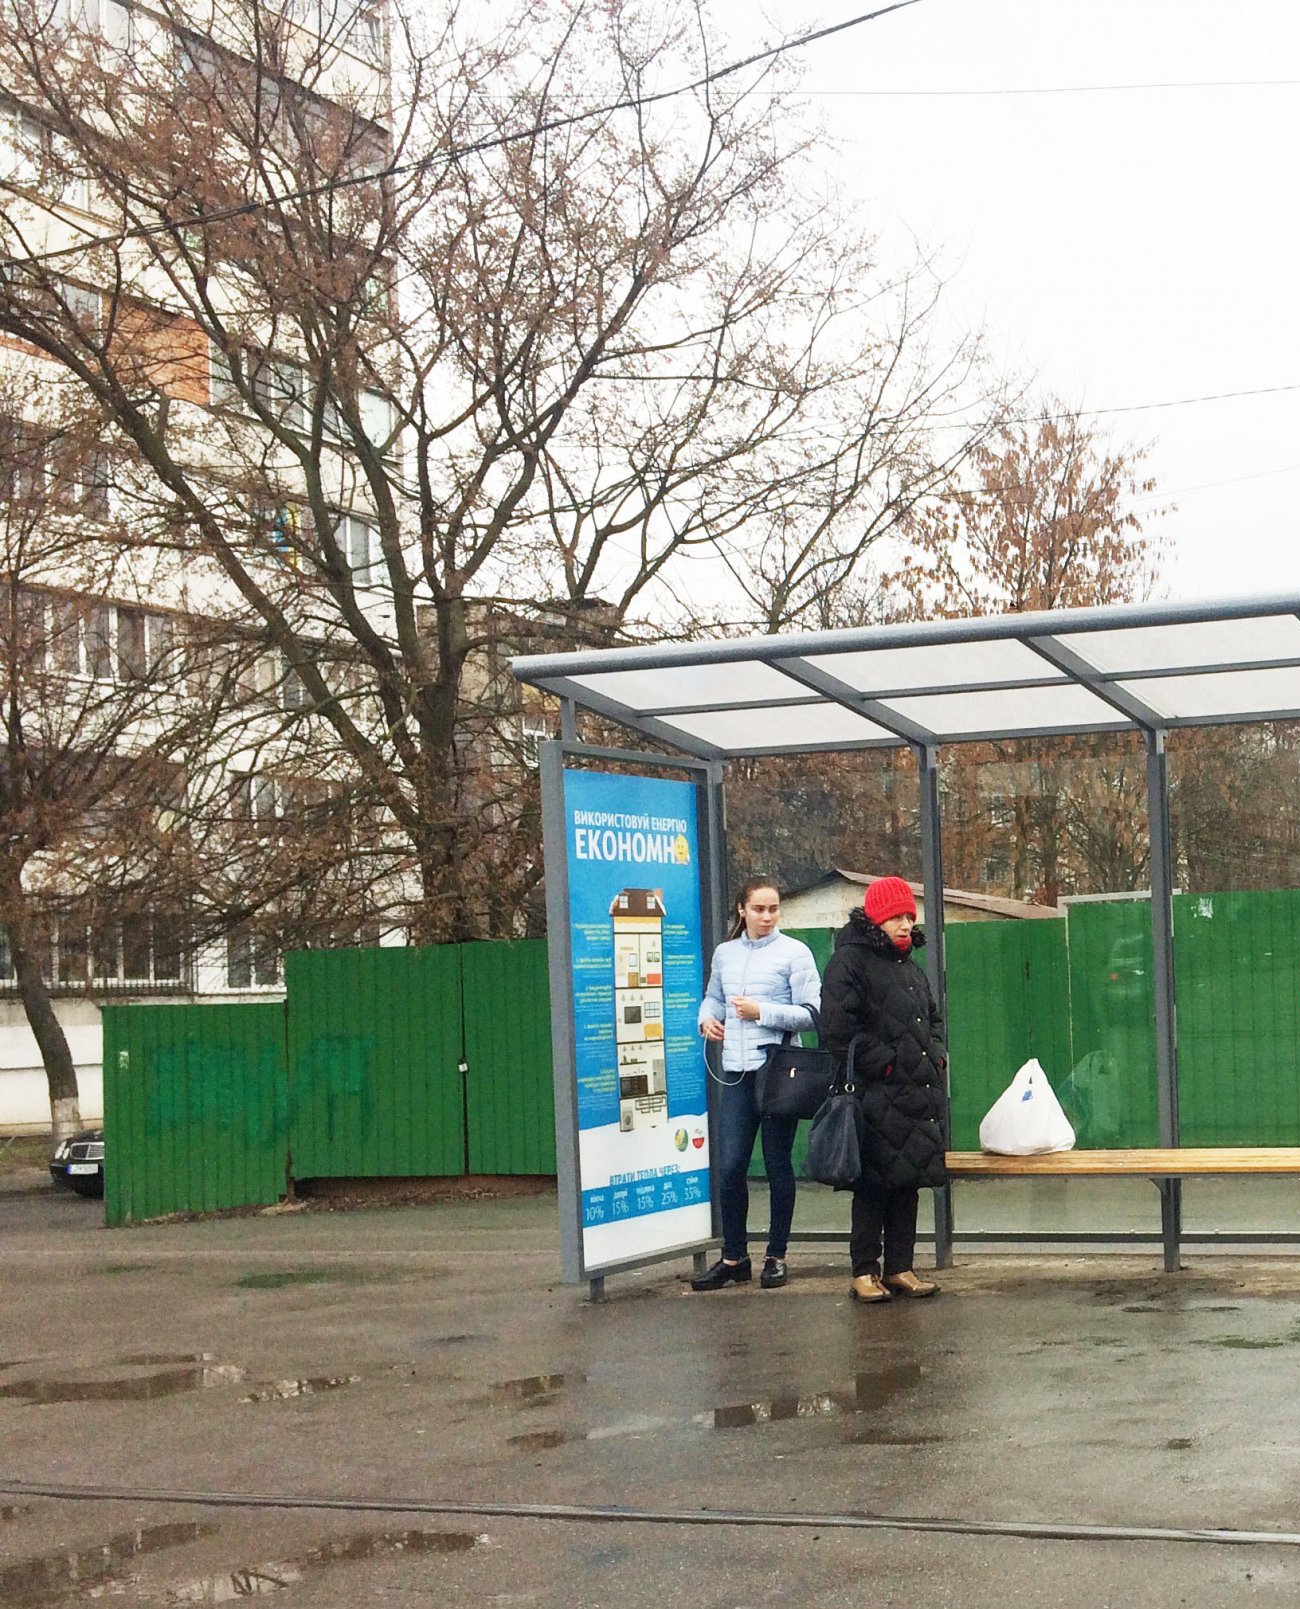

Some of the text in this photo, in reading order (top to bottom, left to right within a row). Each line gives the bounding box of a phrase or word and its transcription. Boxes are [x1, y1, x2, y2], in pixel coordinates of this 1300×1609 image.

[574, 810, 687, 833] ВИКОРИСТОВУЙ ЕНЕРГІЮ
[610, 1173, 635, 1185] ВТРАТИ
[637, 1168, 657, 1181] ТЕПЛА
[586, 1187, 701, 1220] 10% 15% 15% 25% 35%
